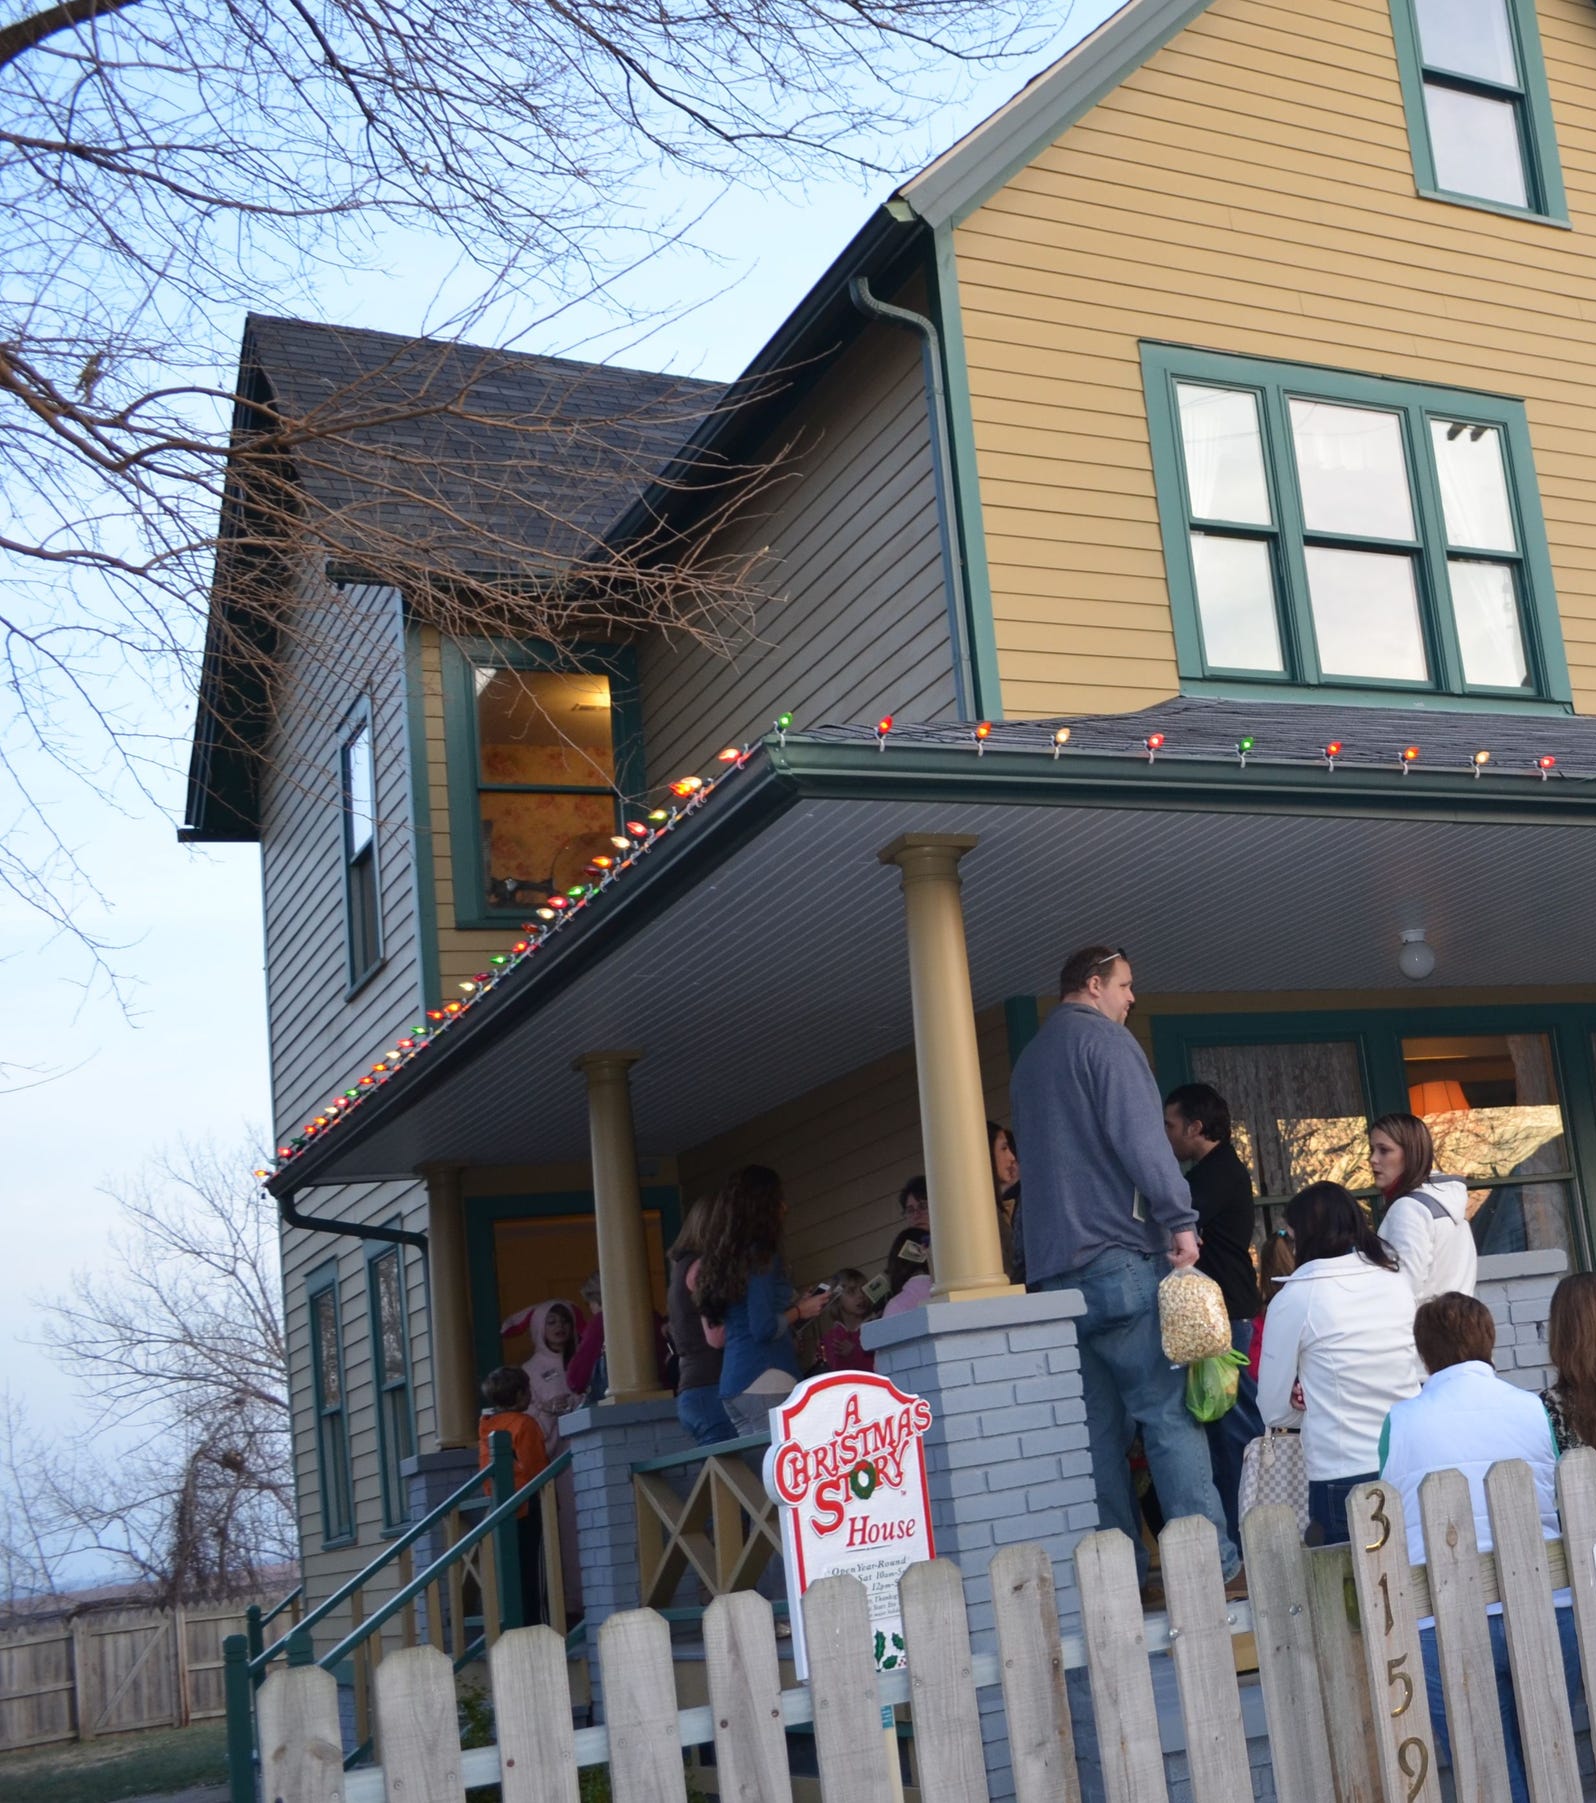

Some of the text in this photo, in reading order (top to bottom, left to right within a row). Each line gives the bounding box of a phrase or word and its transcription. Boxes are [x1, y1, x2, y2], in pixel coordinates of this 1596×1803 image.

[835, 1394, 861, 1436] A
[775, 1400, 931, 1504] CHRISTMAS
[811, 1440, 909, 1535] STORY
[846, 1515, 916, 1547] House
[857, 1556, 906, 1572] Year-Round
[1365, 1488, 1429, 1803] 3159
